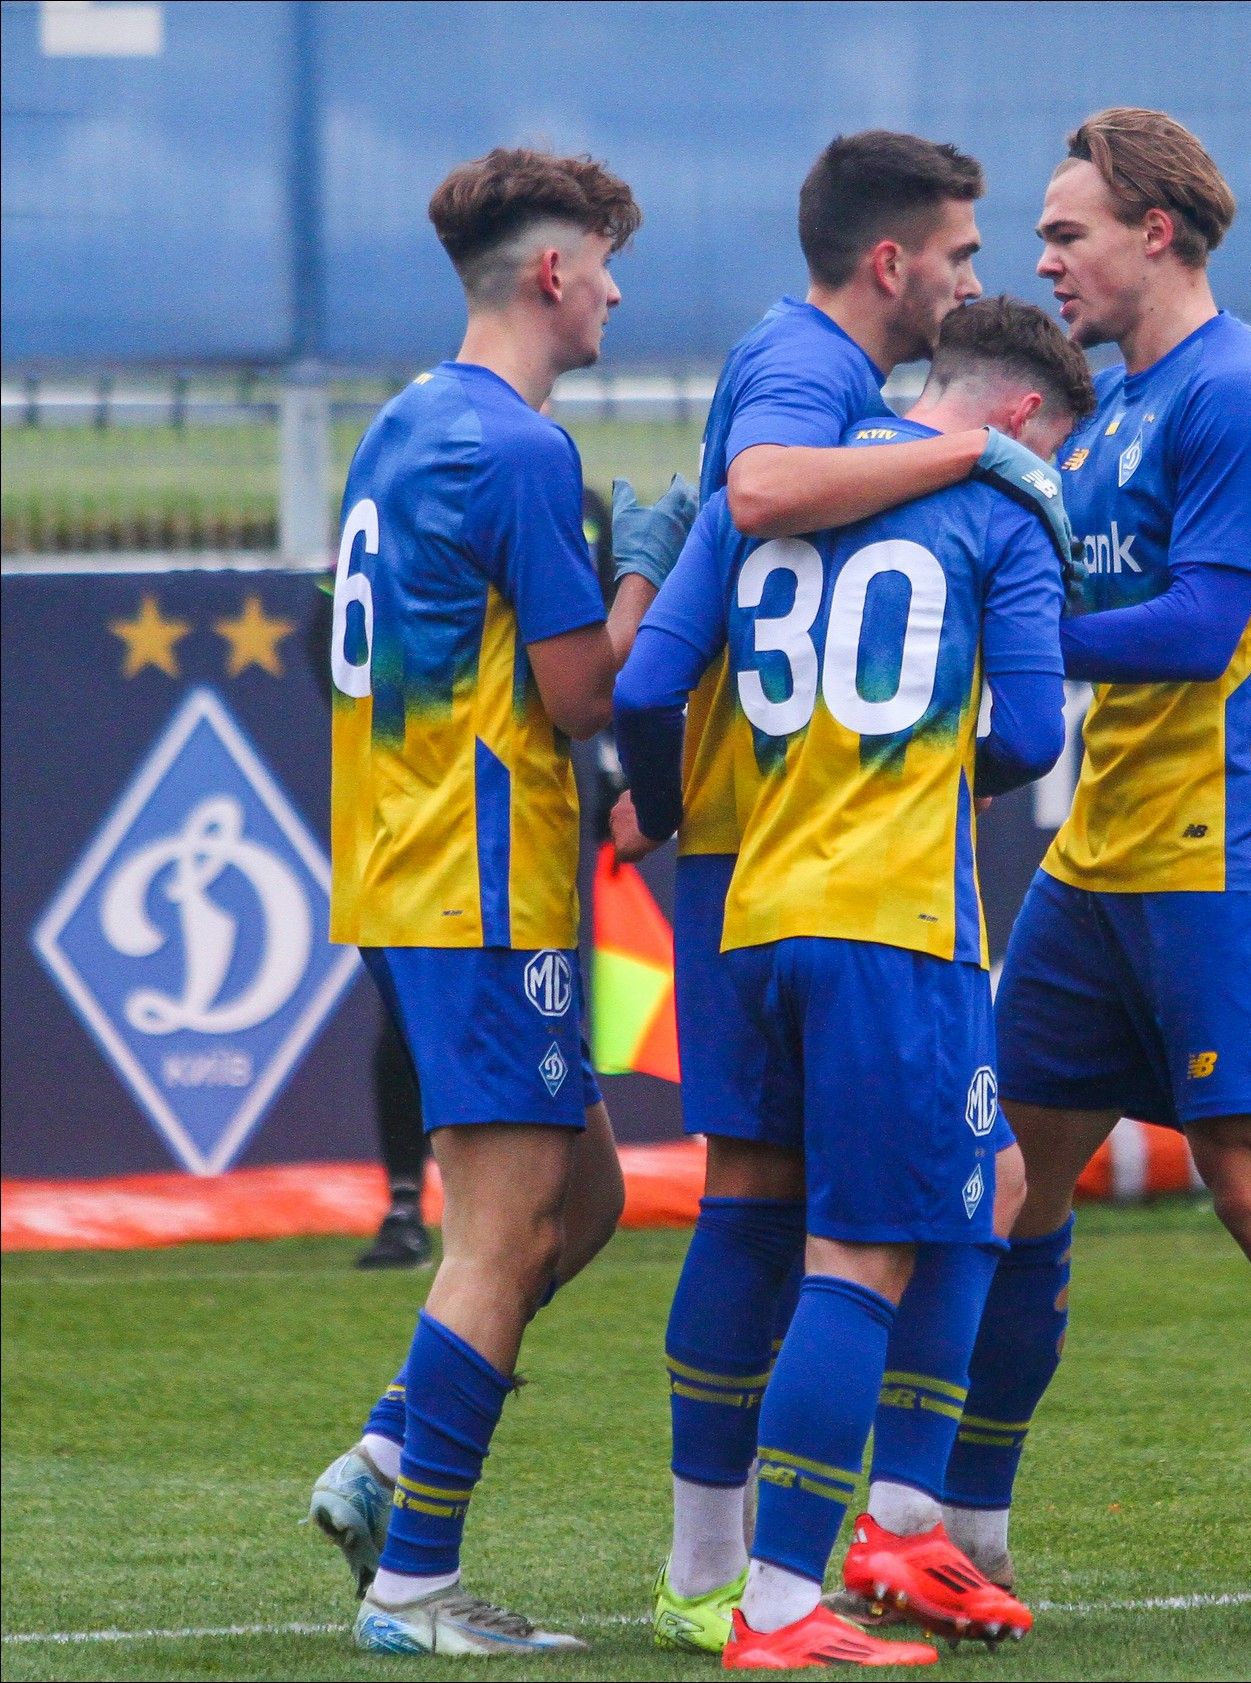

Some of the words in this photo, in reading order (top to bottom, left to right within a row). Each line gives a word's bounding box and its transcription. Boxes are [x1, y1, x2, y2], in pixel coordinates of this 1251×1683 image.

[1082, 521, 1142, 574] ank
[331, 498, 380, 698] 6
[737, 538, 947, 736] 30
[528, 953, 571, 1012] MG
[968, 1071, 997, 1131] MG
